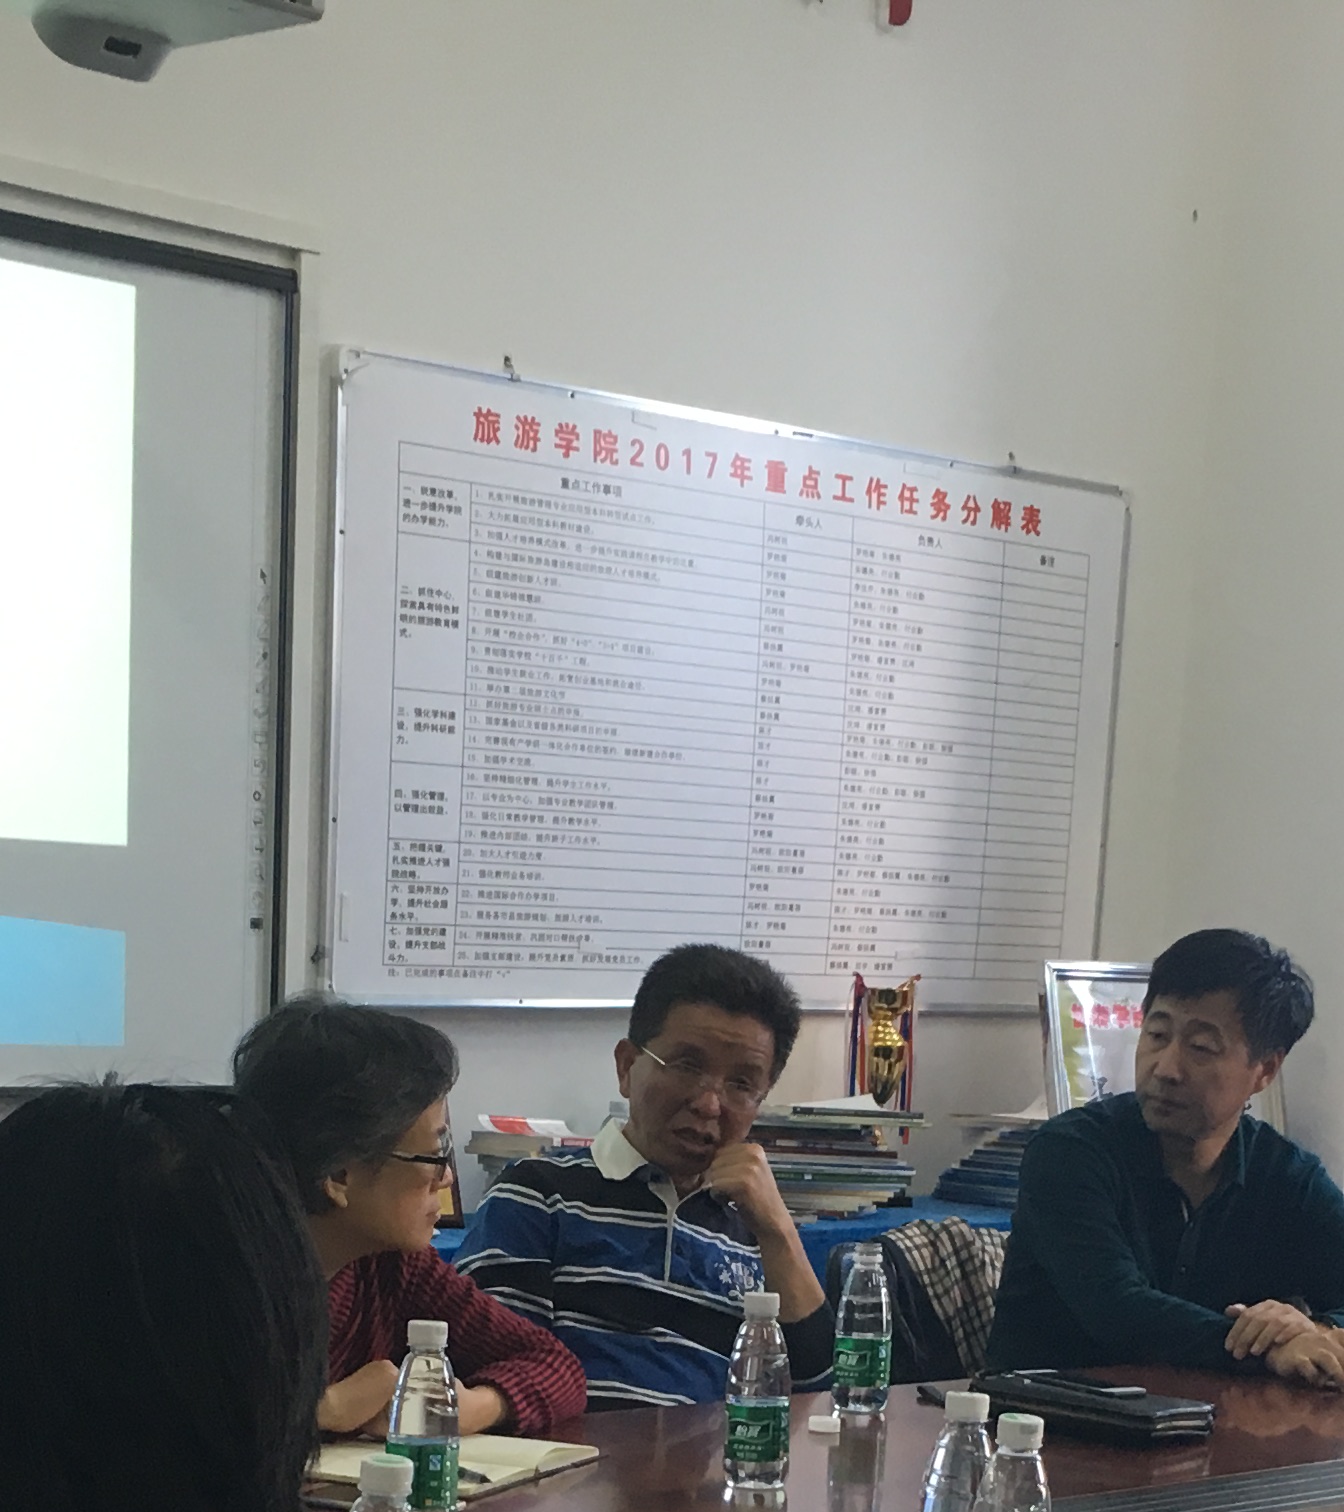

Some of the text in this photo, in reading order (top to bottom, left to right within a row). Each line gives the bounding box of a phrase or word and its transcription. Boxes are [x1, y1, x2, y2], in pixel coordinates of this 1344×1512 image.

[472, 406, 1043, 537] 旅游学院2017年重点工作任务分解表
[561, 477, 623, 497] 重点工作事项
